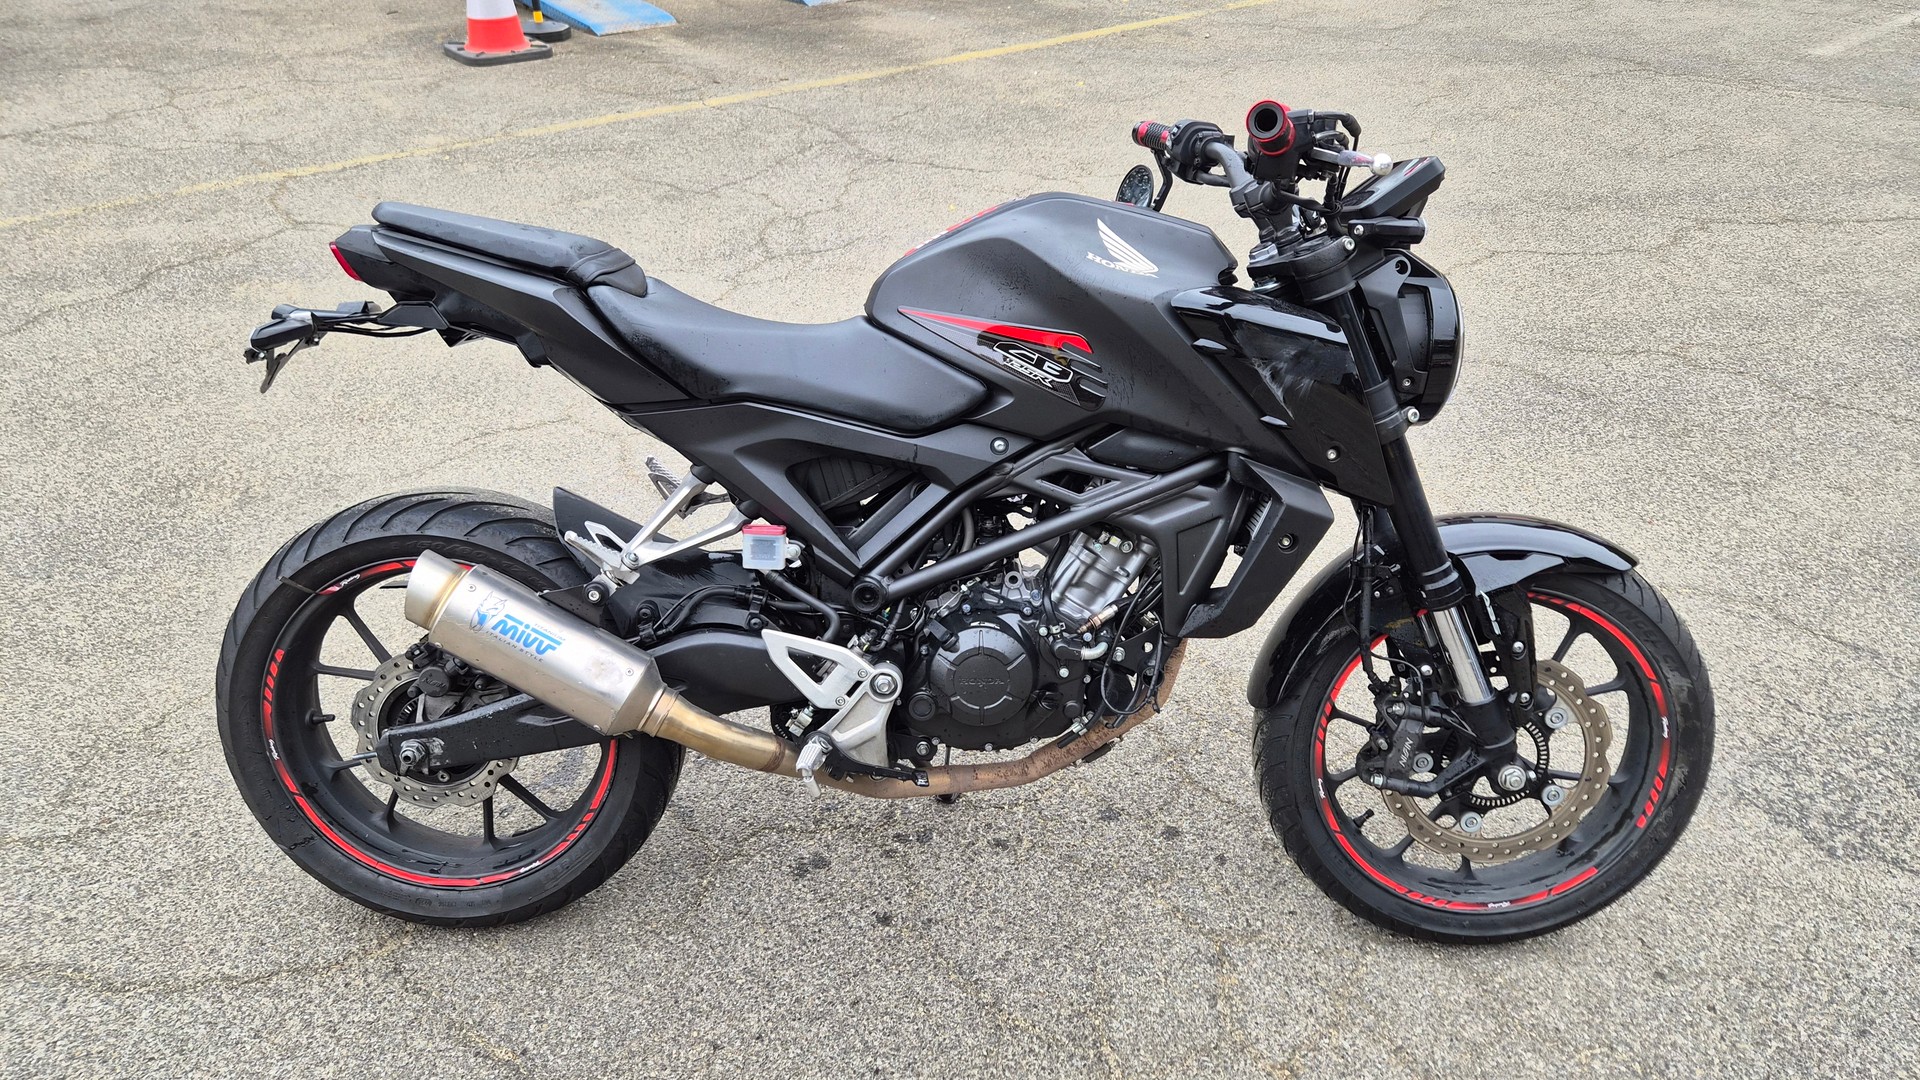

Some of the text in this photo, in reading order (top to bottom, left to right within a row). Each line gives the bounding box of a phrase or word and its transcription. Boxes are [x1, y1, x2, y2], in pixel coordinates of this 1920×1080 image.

[1086, 251, 1159, 278] HON
[485, 630, 544, 662] ITALIAN STYLE
